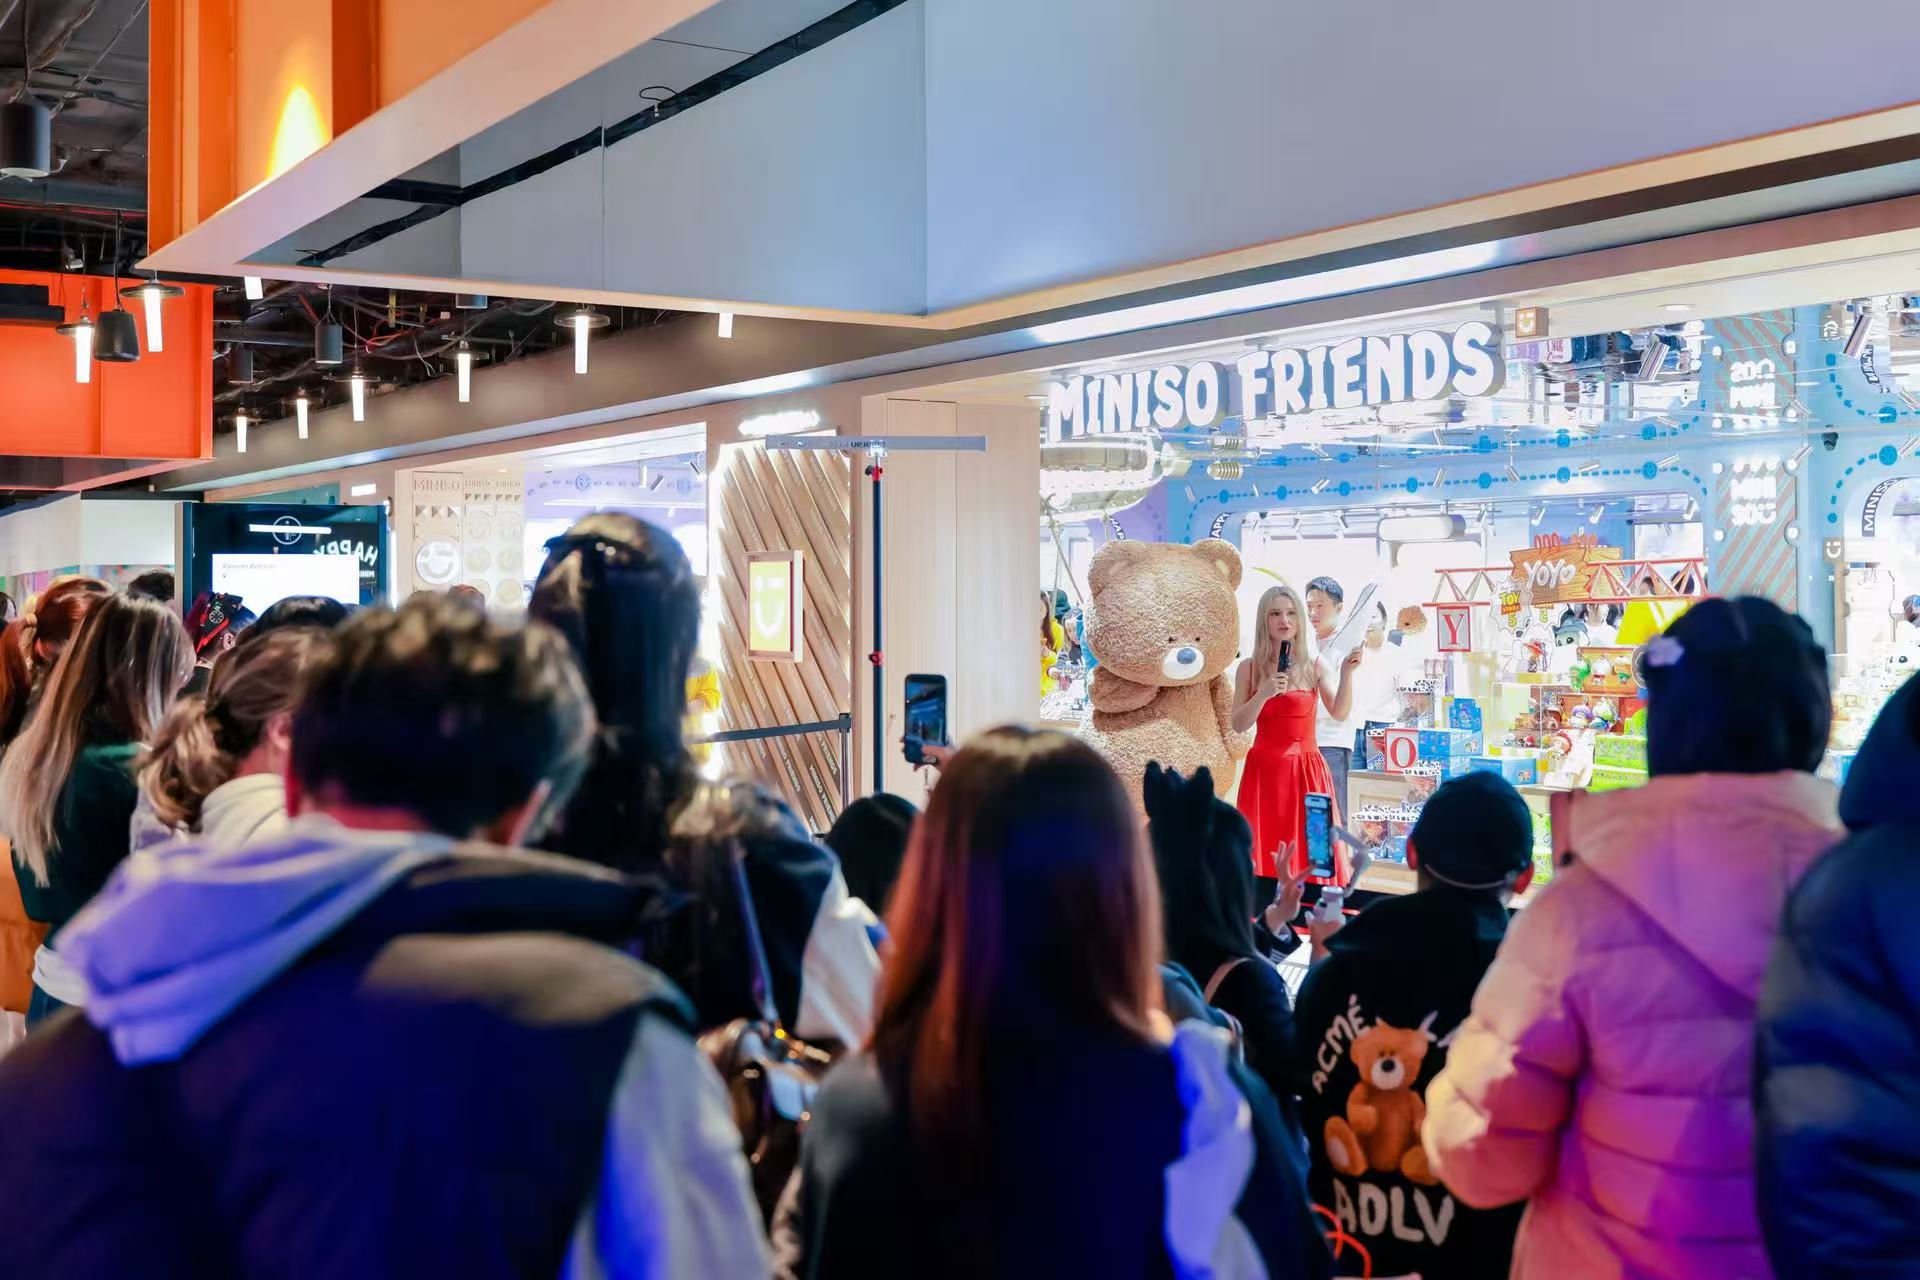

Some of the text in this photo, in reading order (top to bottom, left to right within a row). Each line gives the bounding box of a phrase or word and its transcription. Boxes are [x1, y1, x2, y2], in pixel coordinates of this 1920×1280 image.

[1048, 320, 1499, 443] MINISO FRIENDS
[1499, 592, 1521, 606] TOY
[1442, 614, 1465, 645] Y
[1390, 737, 1417, 769] O
[1333, 1177, 1455, 1247] ADLV
